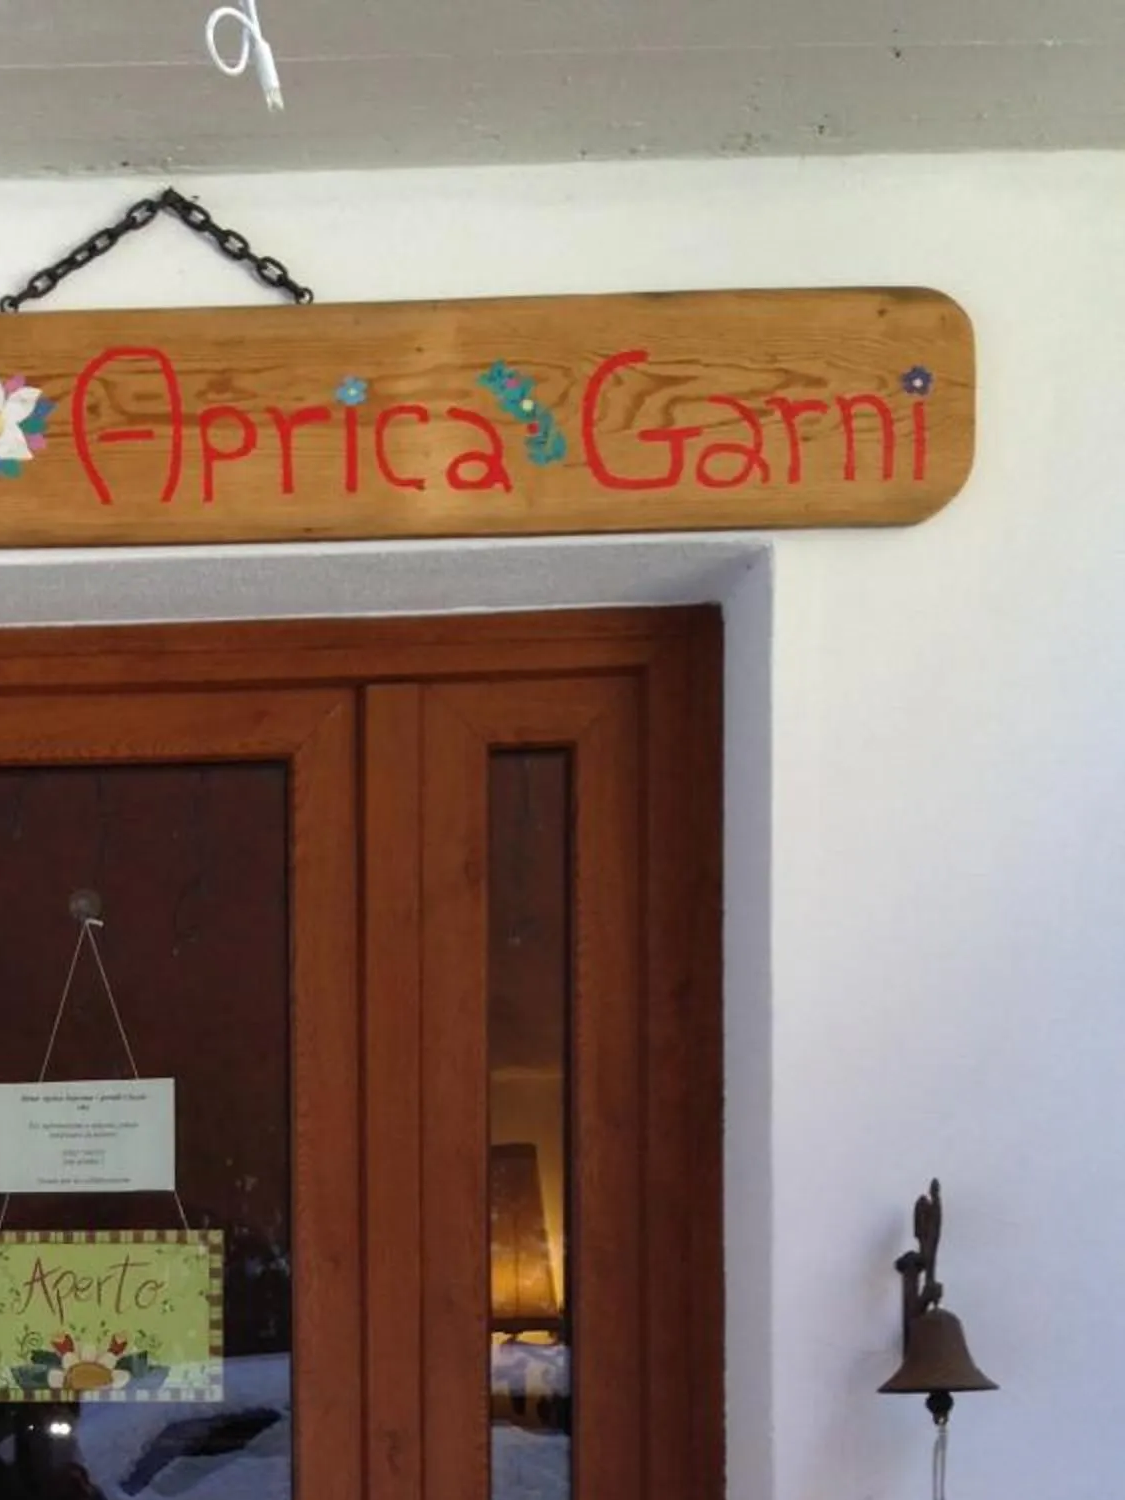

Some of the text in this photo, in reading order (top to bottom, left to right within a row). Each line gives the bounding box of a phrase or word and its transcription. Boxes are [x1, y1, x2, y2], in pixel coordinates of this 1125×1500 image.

[72, 345, 514, 505] Aprica
[581, 350, 931, 492] Garni
[15, 1254, 167, 1324] Aperto
